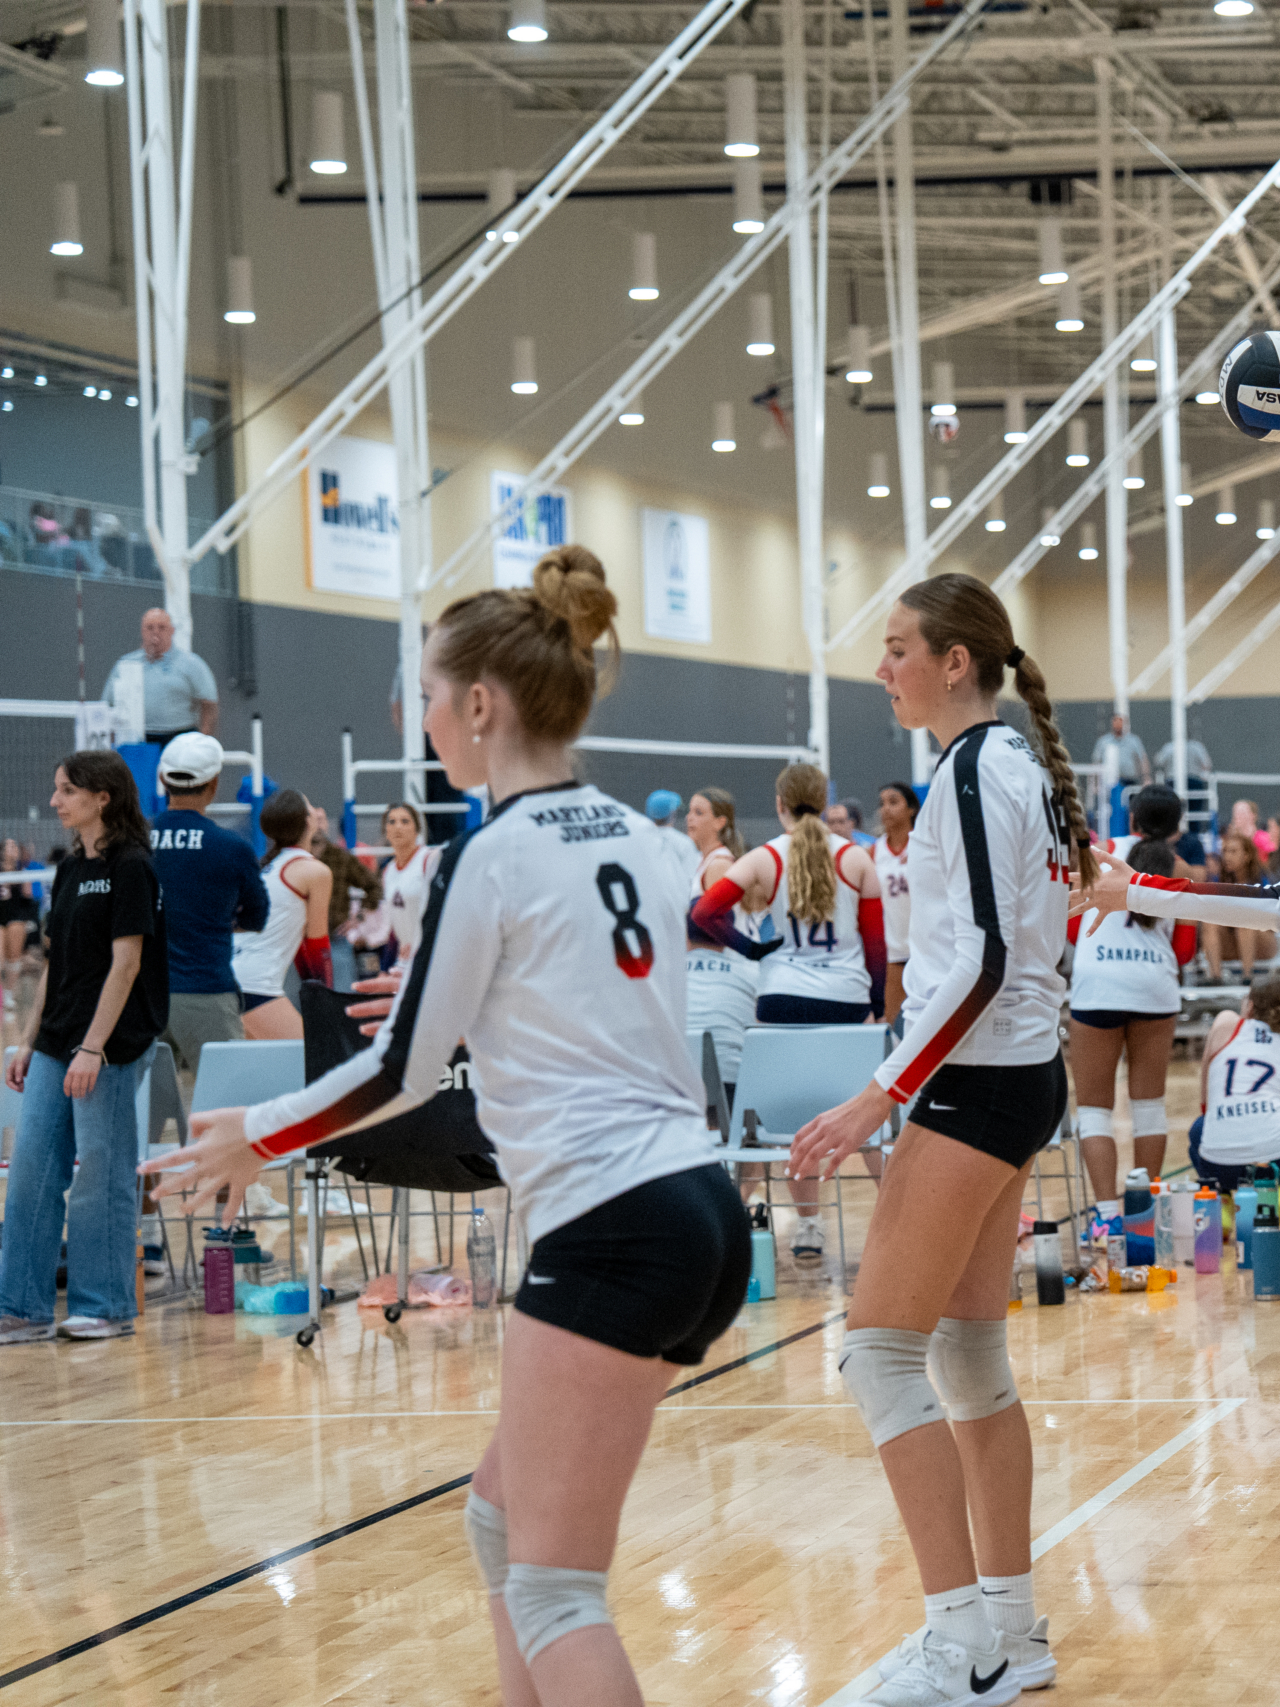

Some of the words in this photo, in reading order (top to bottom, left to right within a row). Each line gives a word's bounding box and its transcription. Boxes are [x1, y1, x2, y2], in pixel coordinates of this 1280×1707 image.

[596, 862, 654, 979] 8
[1225, 1058, 1276, 1097] 17
[1216, 1101, 1277, 1120] KNEISEL
